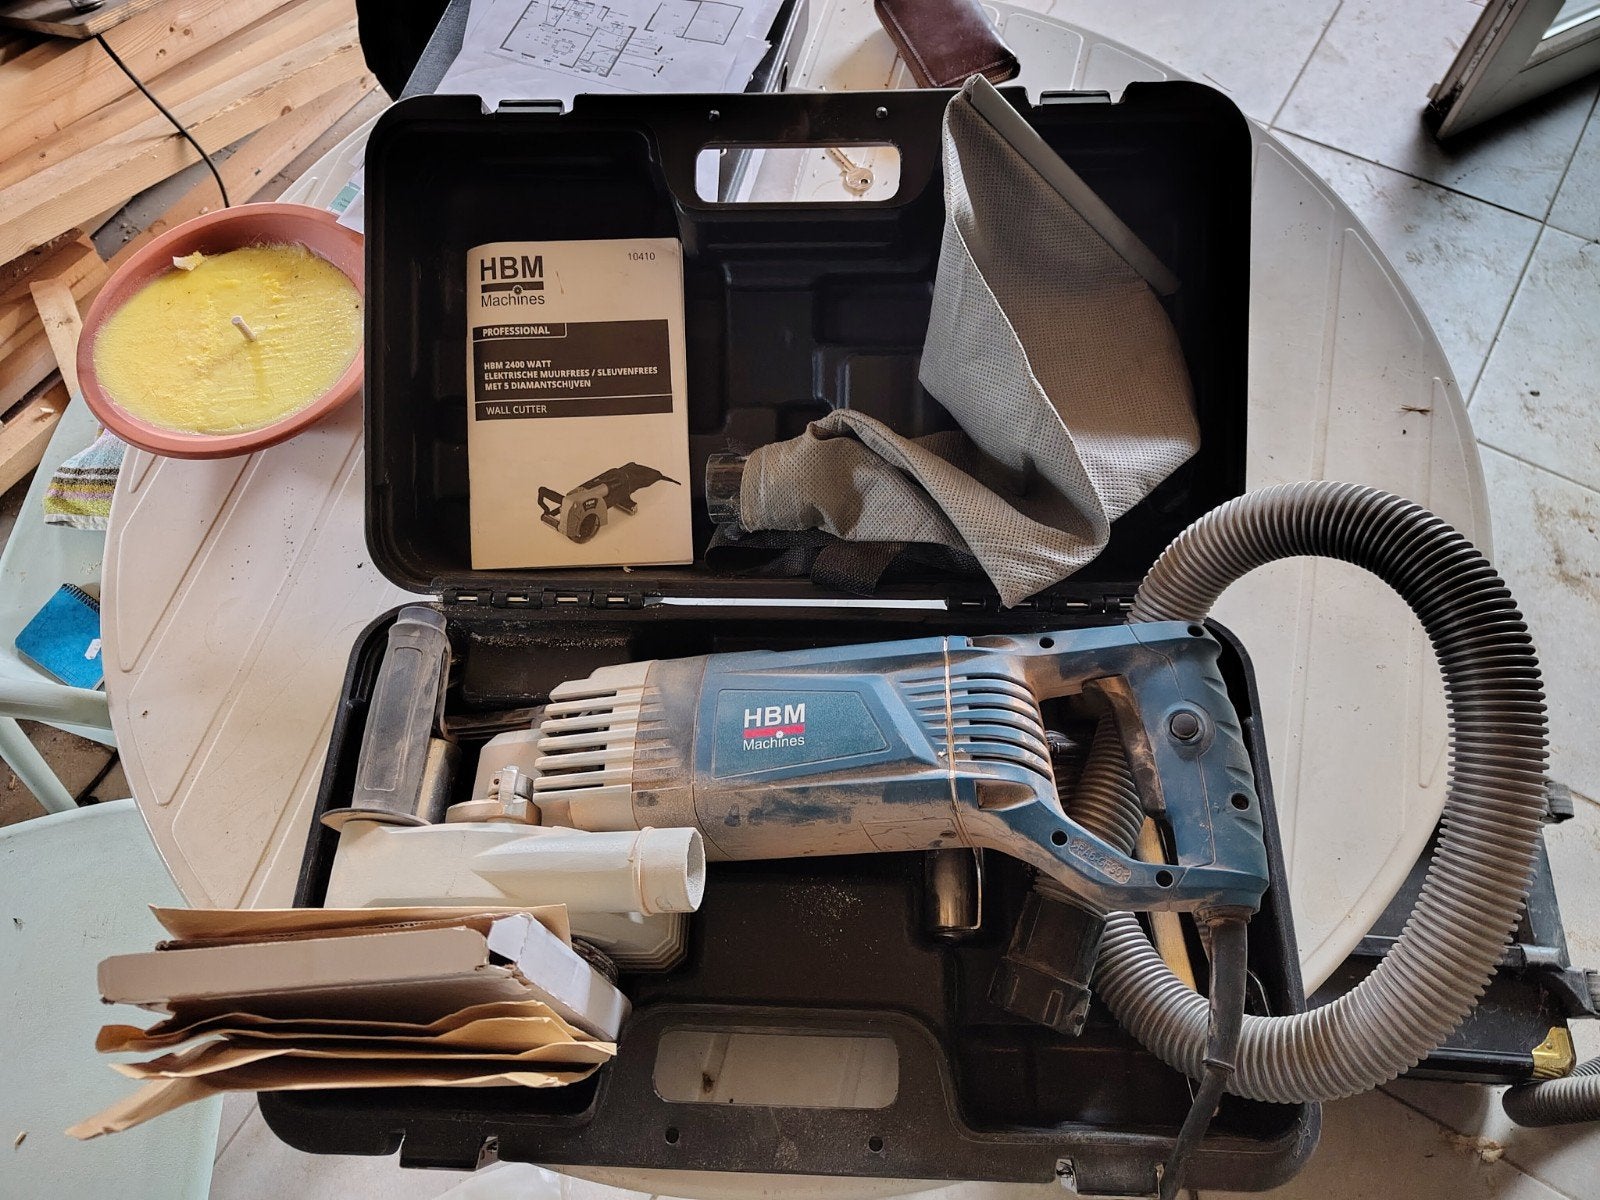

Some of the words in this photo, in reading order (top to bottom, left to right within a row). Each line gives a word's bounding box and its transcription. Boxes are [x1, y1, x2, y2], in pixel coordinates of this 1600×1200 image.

[628, 252, 656, 261] 10410
[480, 255, 544, 281] HBM
[481, 293, 545, 307] Machines
[482, 326, 550, 337] PROFESSIONAL
[484, 361, 503, 370] HBM
[504, 360, 525, 369] 2400
[526, 360, 552, 369] WATT
[484, 370, 538, 380] ELEKTRISCHE
[540, 369, 590, 378] MUURFREES
[597, 366, 658, 376] SLEUVENFREES
[485, 381, 503, 391] MET
[503, 381, 509, 390] 5
[511, 379, 591, 390] DIAMANTSCHIJVEN
[486, 406, 511, 415] WALL
[512, 405, 547, 414] CUTTER
[743, 703, 805, 728] HBM
[743, 737, 805, 750] Machines
